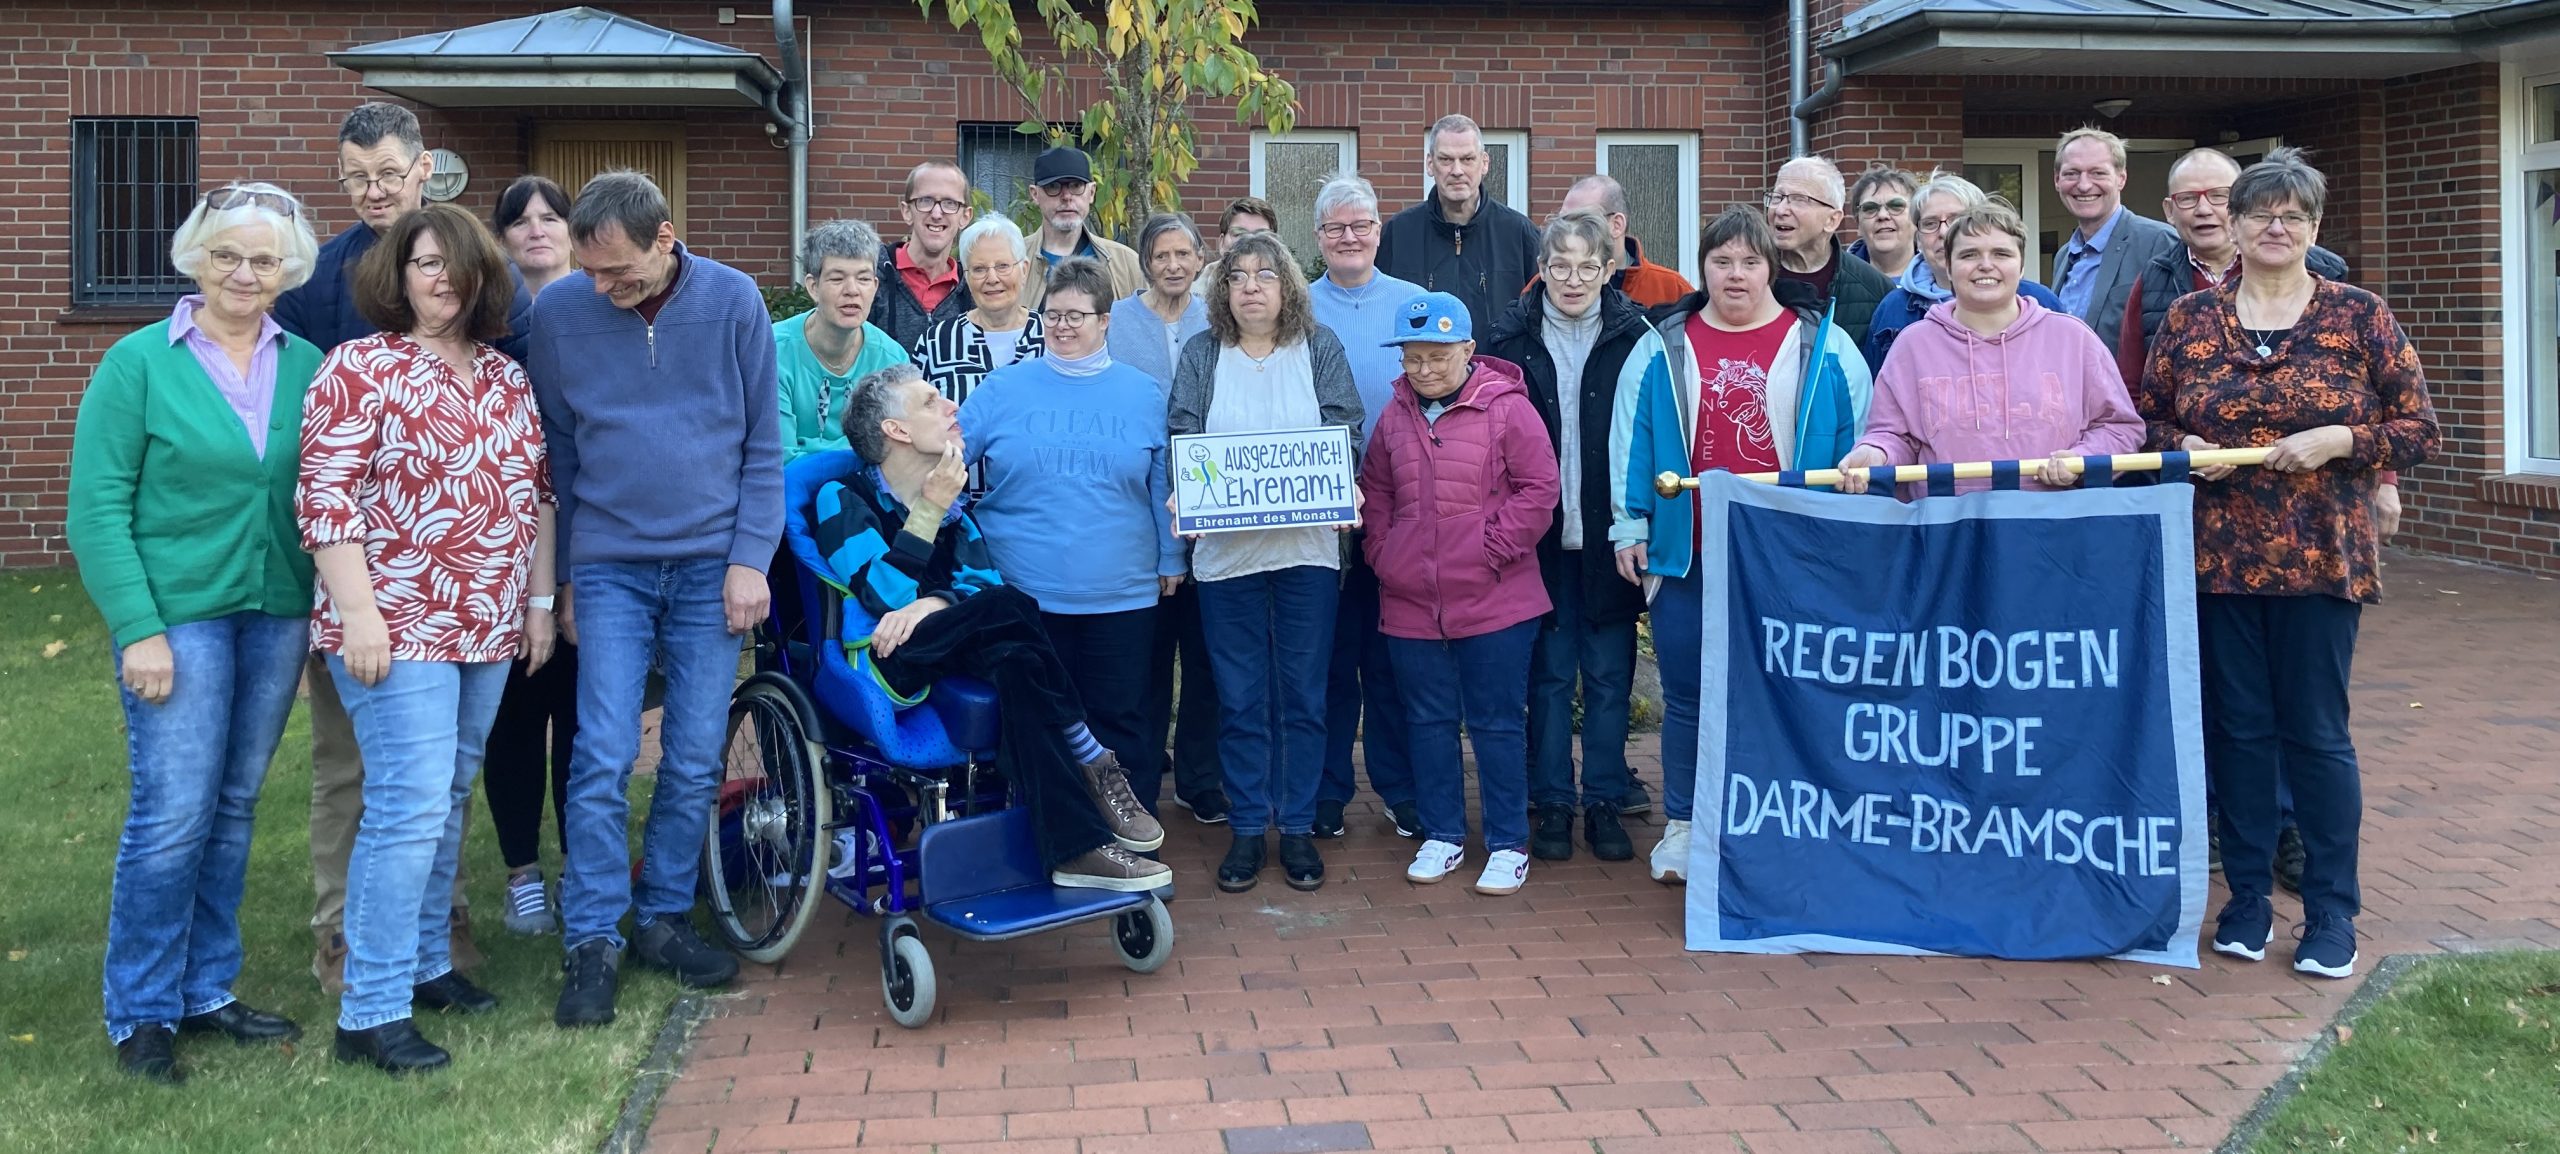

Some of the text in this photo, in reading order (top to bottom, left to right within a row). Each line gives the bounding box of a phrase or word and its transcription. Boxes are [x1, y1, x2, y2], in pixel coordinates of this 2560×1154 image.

[1024, 407, 1128, 442] CLEAR
[1701, 397, 1715, 461] NICE
[1918, 372, 2070, 438] UCLA
[1031, 446, 1119, 477] VIEW
[1225, 473, 1346, 508] Ehrenamt
[1195, 510, 1340, 528] Ehrenamt des Monats
[1844, 702, 2043, 777] GRUPPE
[1726, 772, 2177, 877] DARME-BRAMSCHE
